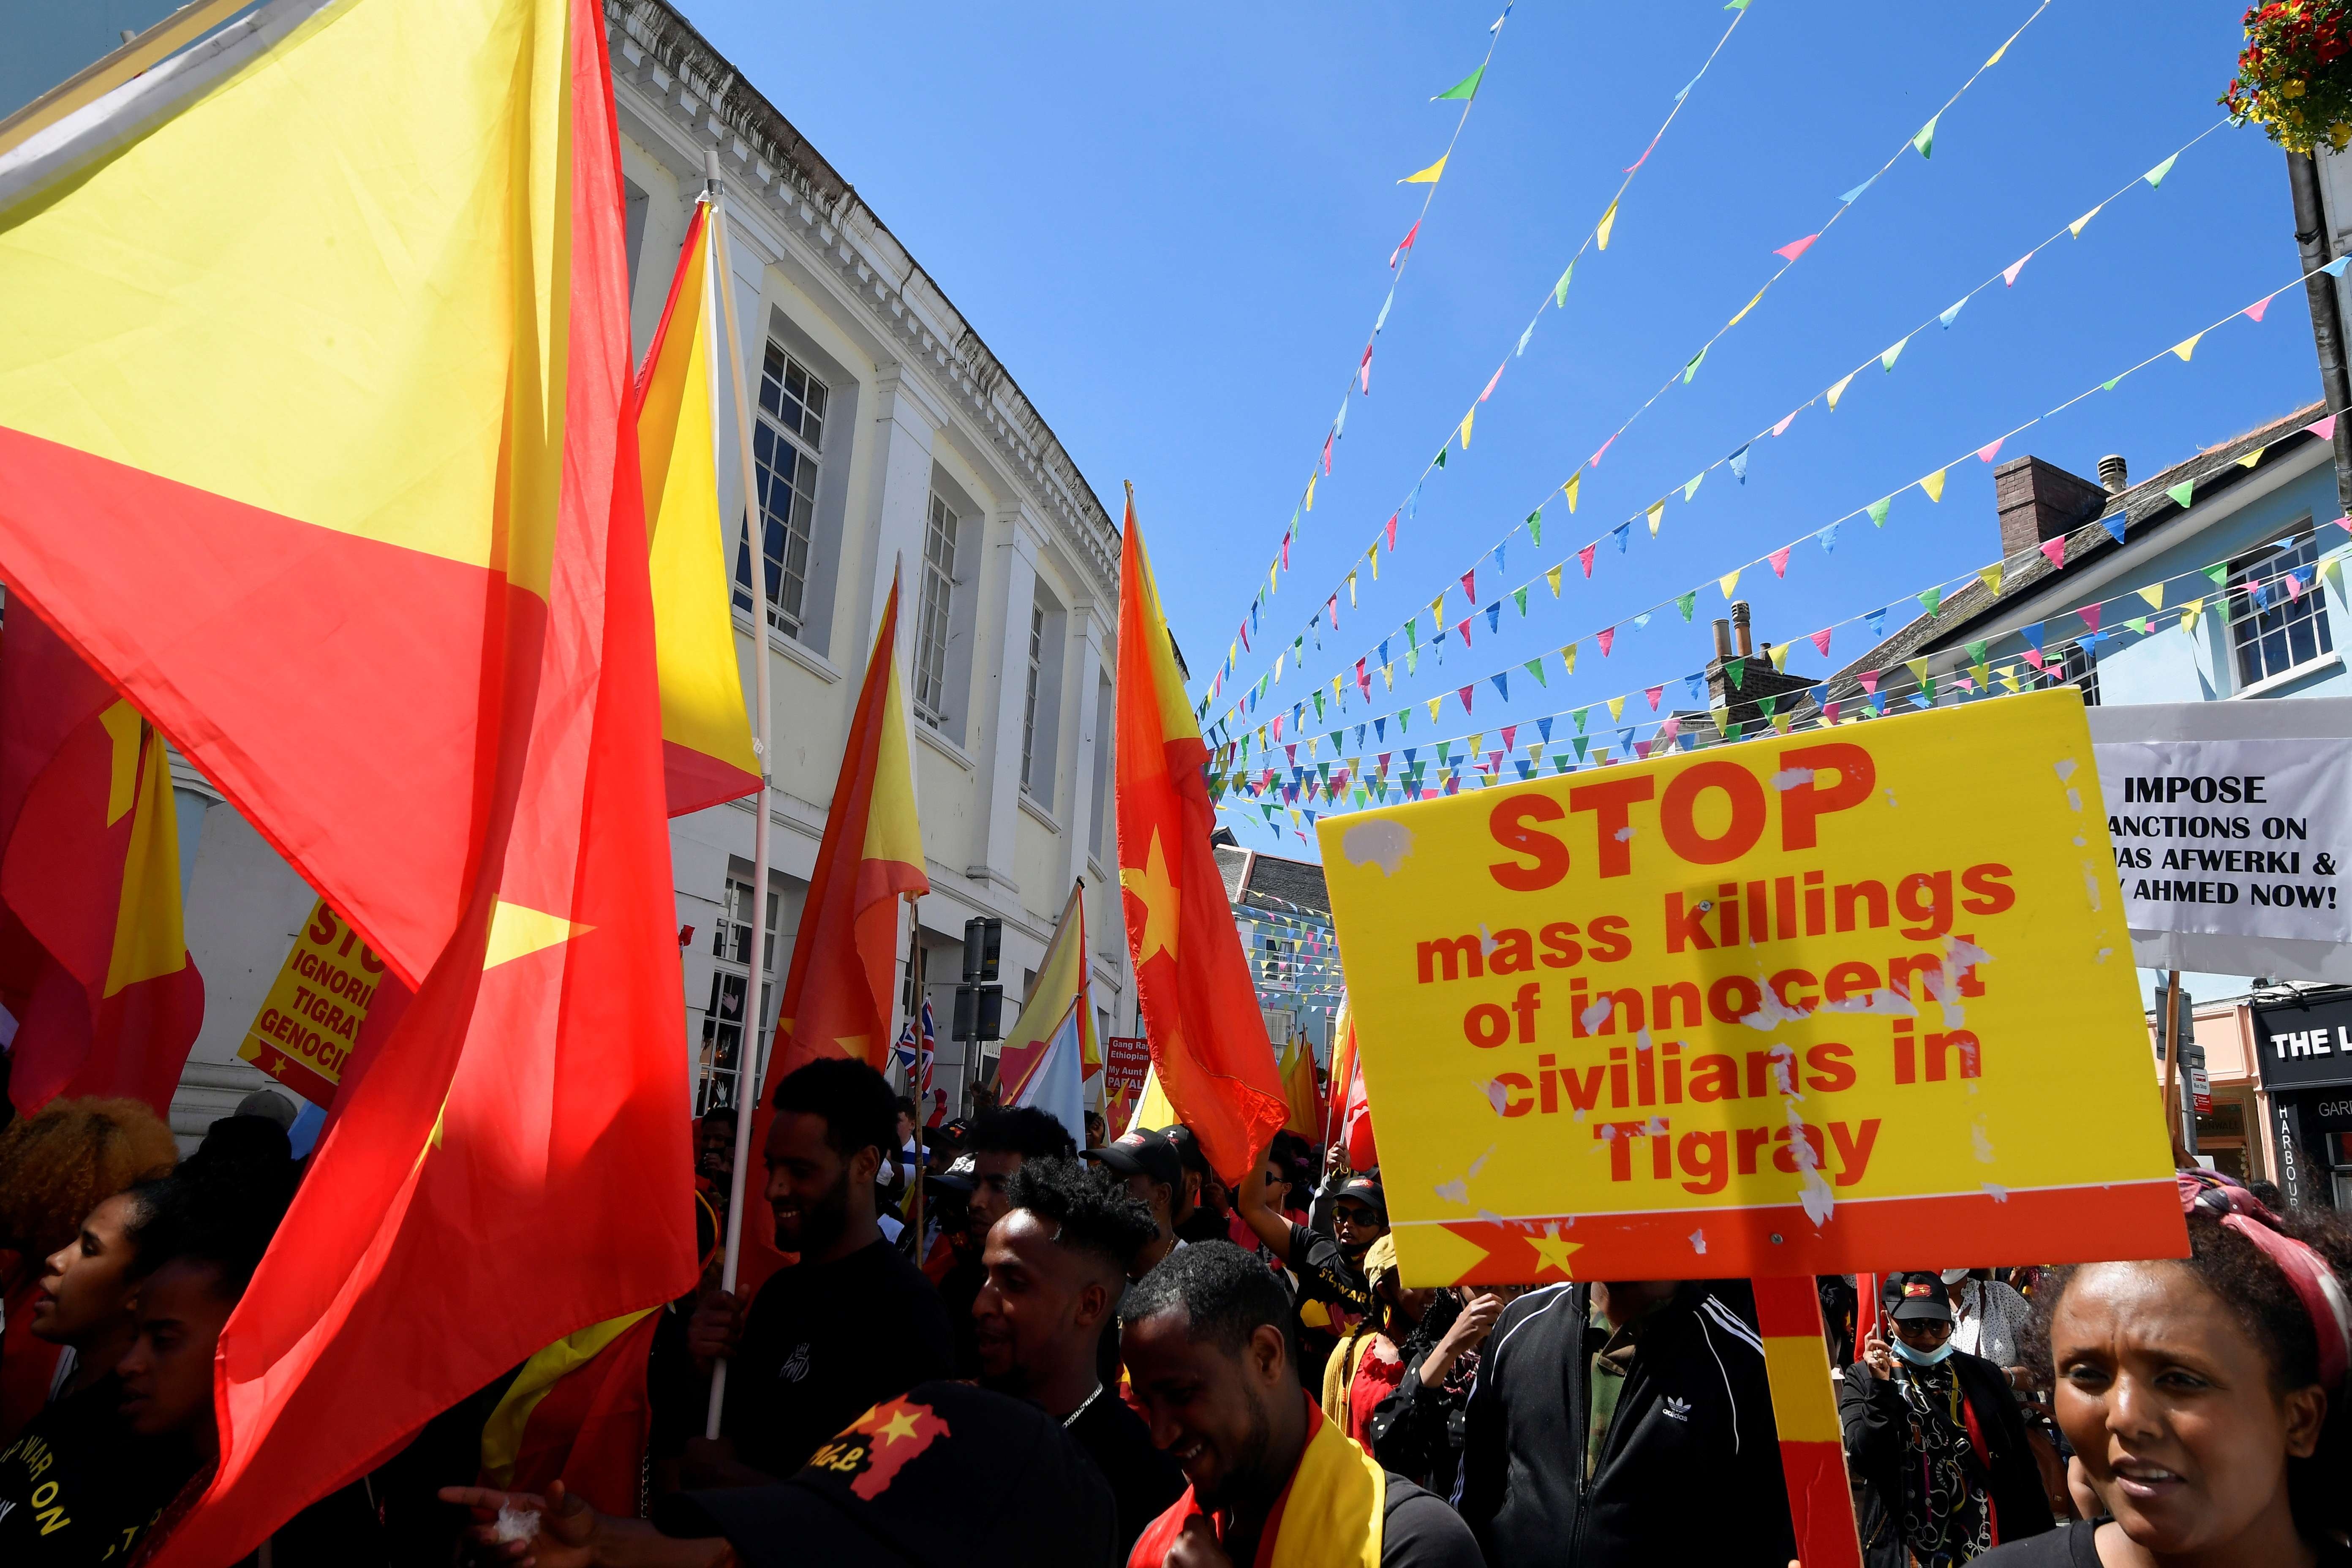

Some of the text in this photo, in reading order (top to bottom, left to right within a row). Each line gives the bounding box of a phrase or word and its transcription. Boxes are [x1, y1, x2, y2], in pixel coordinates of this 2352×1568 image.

[2125, 776, 2267, 803] IMPOSE
[1489, 743, 1876, 892] STOP
[2108, 816, 2306, 840] ANCTIONS ON
[2161, 849, 2299, 874] AFWERKI
[2313, 852, 2336, 875] &
[2134, 879, 2336, 909] AHMED NOW!
[1417, 863, 2015, 984] mass killings
[1464, 934, 1985, 1048] of innocent
[1111, 1051, 1148, 1061] Ethiopian
[1113, 1040, 1133, 1050] Gang
[2270, 1028, 2331, 1058] THE
[1109, 1066, 1119, 1075] My
[1122, 1067, 1142, 1076] Aunt
[1489, 1018, 1981, 1117] civilians in
[1108, 1077, 1145, 1089] PARAL
[2319, 1101, 2352, 1116] GAR
[2196, 1122, 2240, 1130] ORNWALL
[1593, 1117, 1881, 1195] Tigray
[1662, 1408, 1688, 1422] adidas
[19, 1435, 53, 1482] WAR
[31, 1481, 71, 1536] ON
